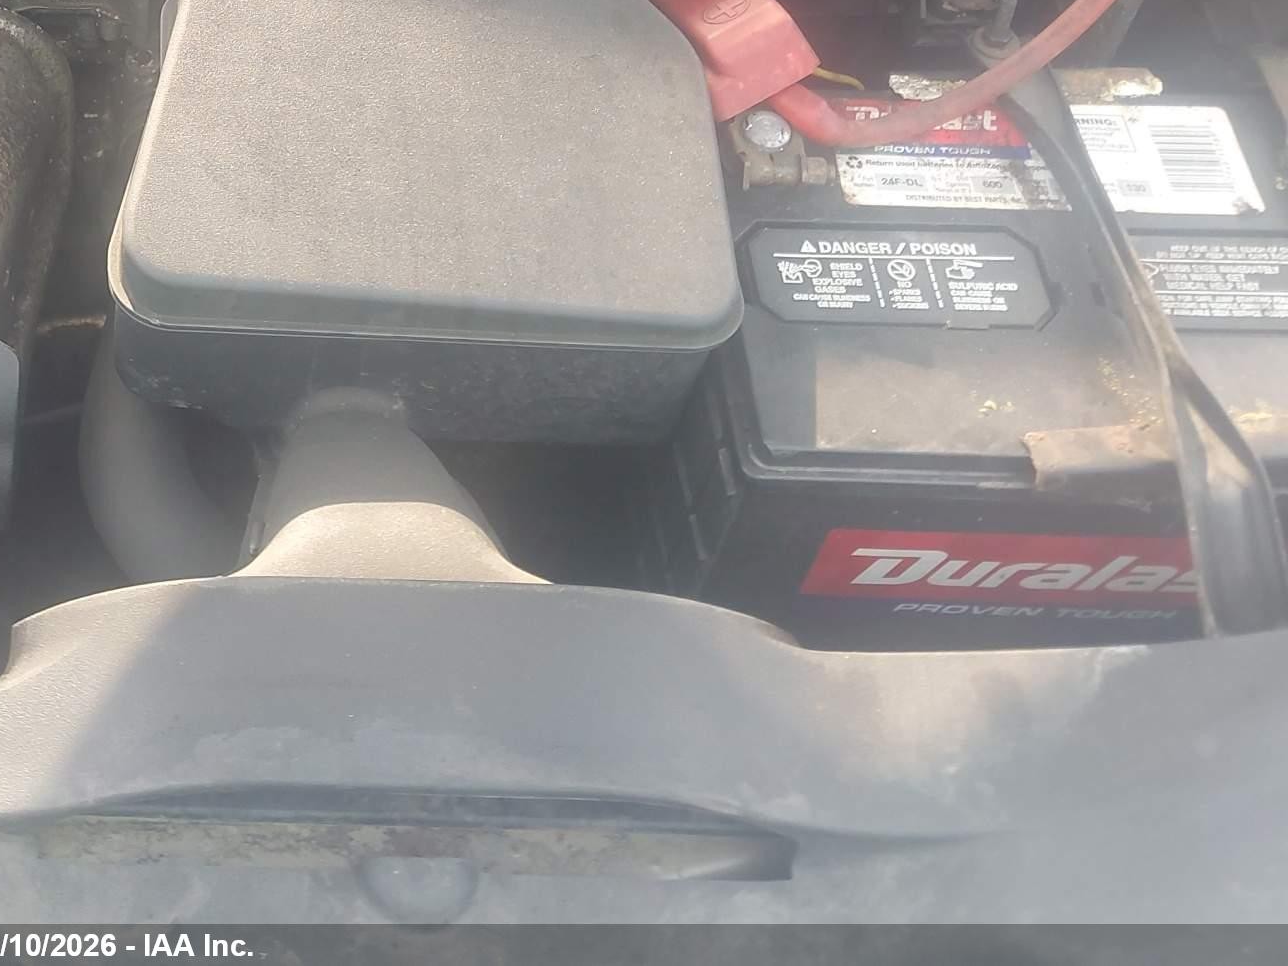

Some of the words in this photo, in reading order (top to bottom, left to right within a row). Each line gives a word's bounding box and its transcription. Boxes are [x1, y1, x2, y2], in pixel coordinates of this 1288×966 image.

[874, 145, 935, 155] PROVEN
[940, 146, 992, 155] TOUGH
[880, 177, 924, 187] 24F-DL
[818, 241, 892, 255] DANGER
[909, 242, 978, 255] POISON
[830, 262, 864, 271] SHIELD
[832, 270, 857, 278] EYES
[812, 277, 864, 287] EXPLOSIVE
[896, 280, 913, 289] NO
[948, 281, 994, 291] SULFURIC
[995, 282, 1018, 291] ACID
[814, 286, 847, 294] GASES
[893, 602, 1053, 618] PROVEN
[1055, 607, 1178, 620] TOUGH
